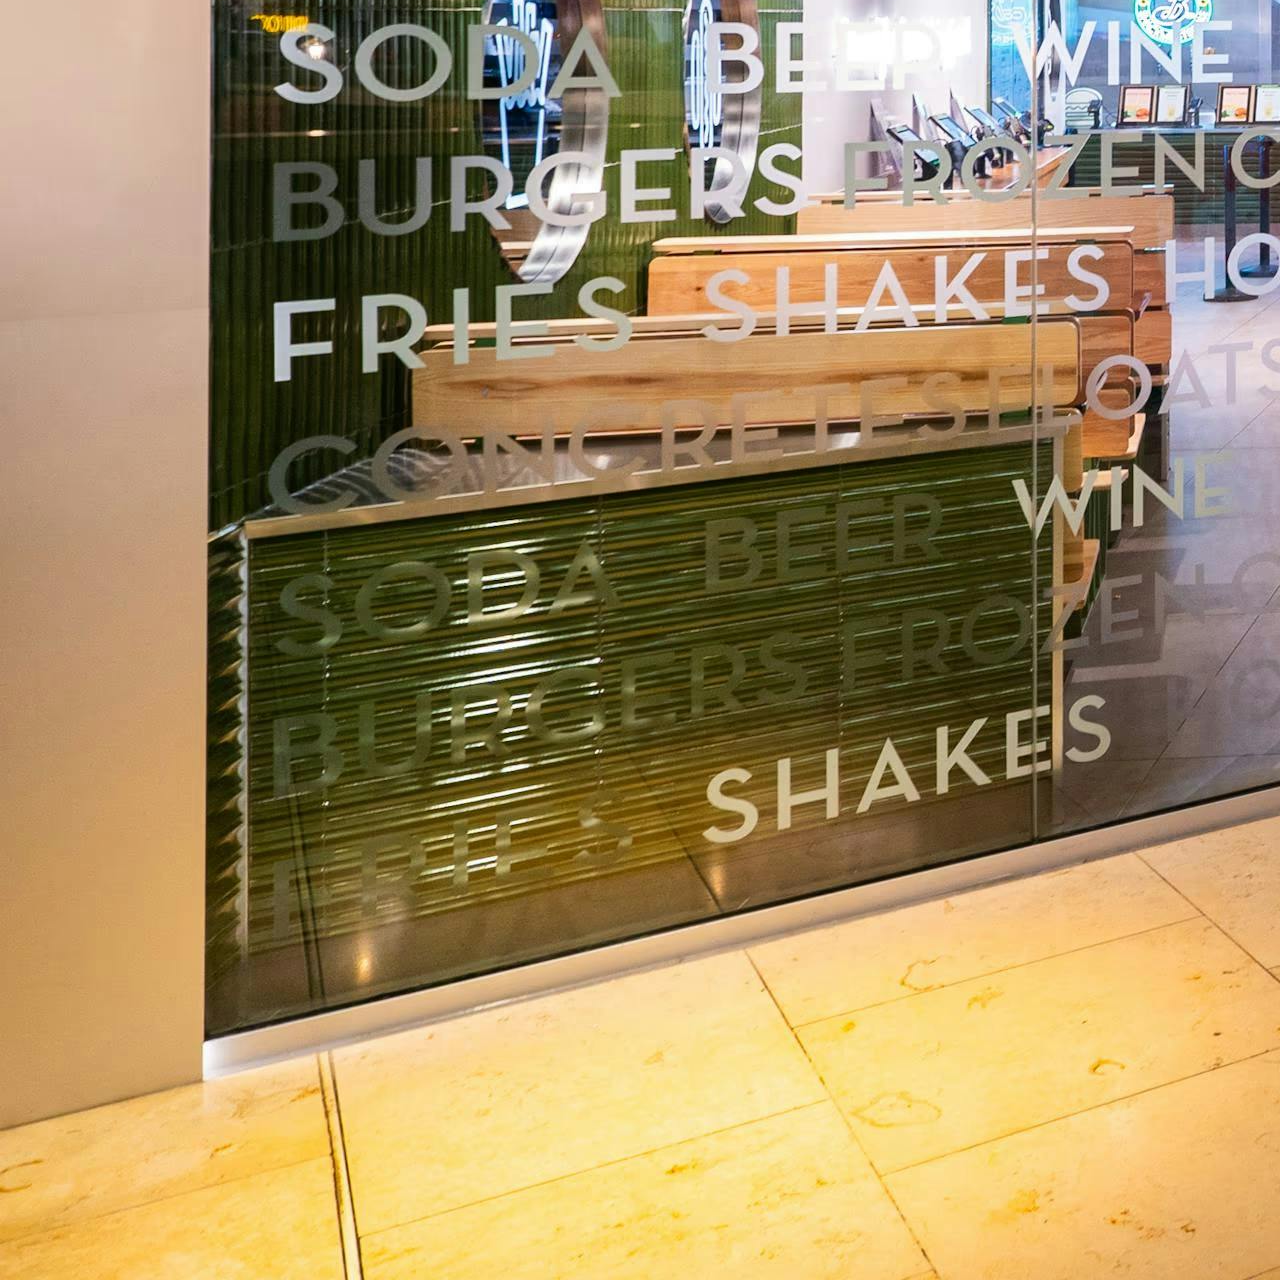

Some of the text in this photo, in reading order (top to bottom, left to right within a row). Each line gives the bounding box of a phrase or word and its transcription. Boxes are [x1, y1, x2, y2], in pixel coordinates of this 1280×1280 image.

[274, 23, 622, 105] SODA
[1013, 19, 1234, 88] WINE
[273, 143, 807, 241] BURGERS
[844, 126, 1205, 207] FROZEN
[274, 277, 632, 382] FRIES
[700, 245, 1110, 344] SHAKES
[268, 371, 968, 516] CONCRETES
[275, 539, 620, 656] SODA
[704, 492, 944, 592] BEER
[1012, 453, 1233, 540] WINE
[274, 632, 808, 800] BURGERS
[703, 696, 1111, 845] SHAKES
